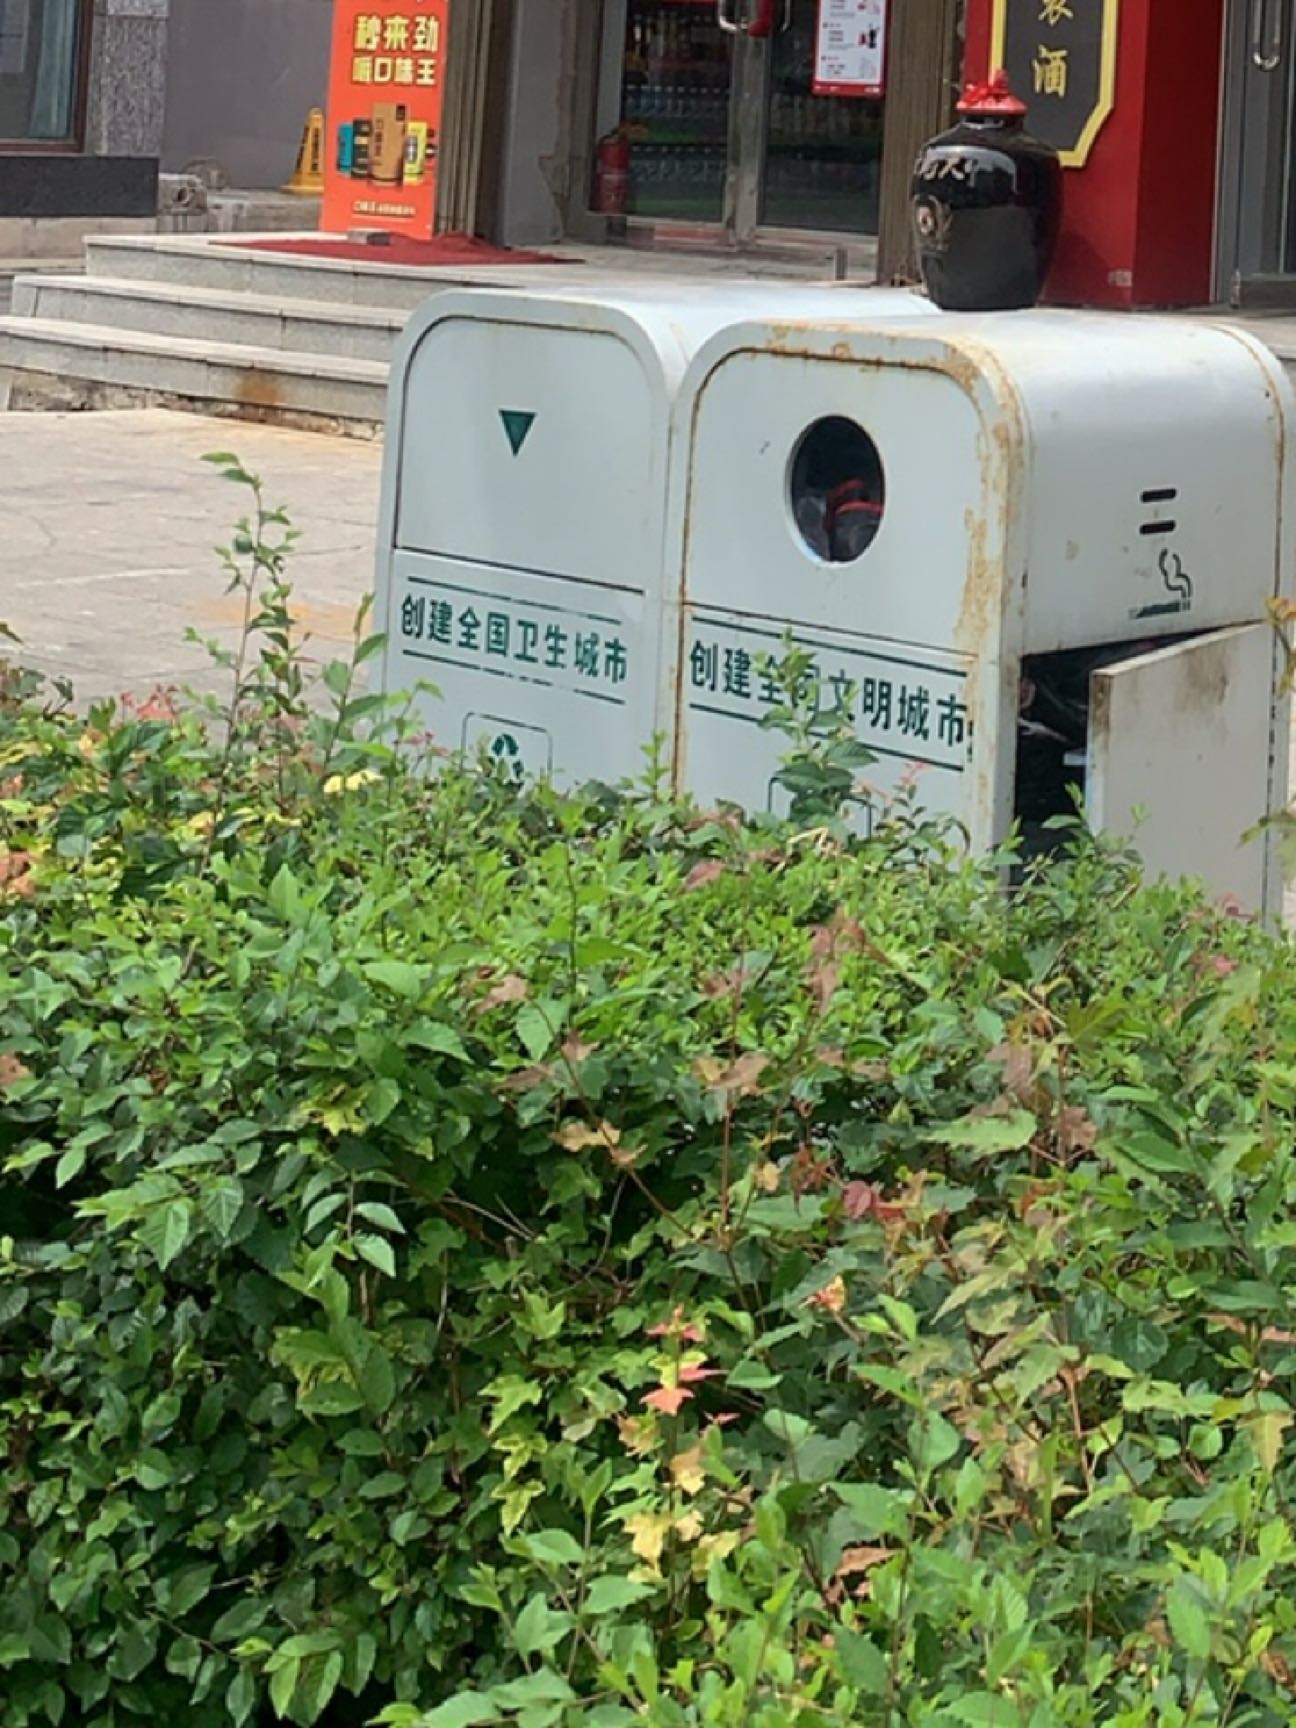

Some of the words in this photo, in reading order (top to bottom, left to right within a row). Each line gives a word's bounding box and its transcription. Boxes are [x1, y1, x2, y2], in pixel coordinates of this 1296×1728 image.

[401, 592, 627, 683] 创建全国卫生城市
